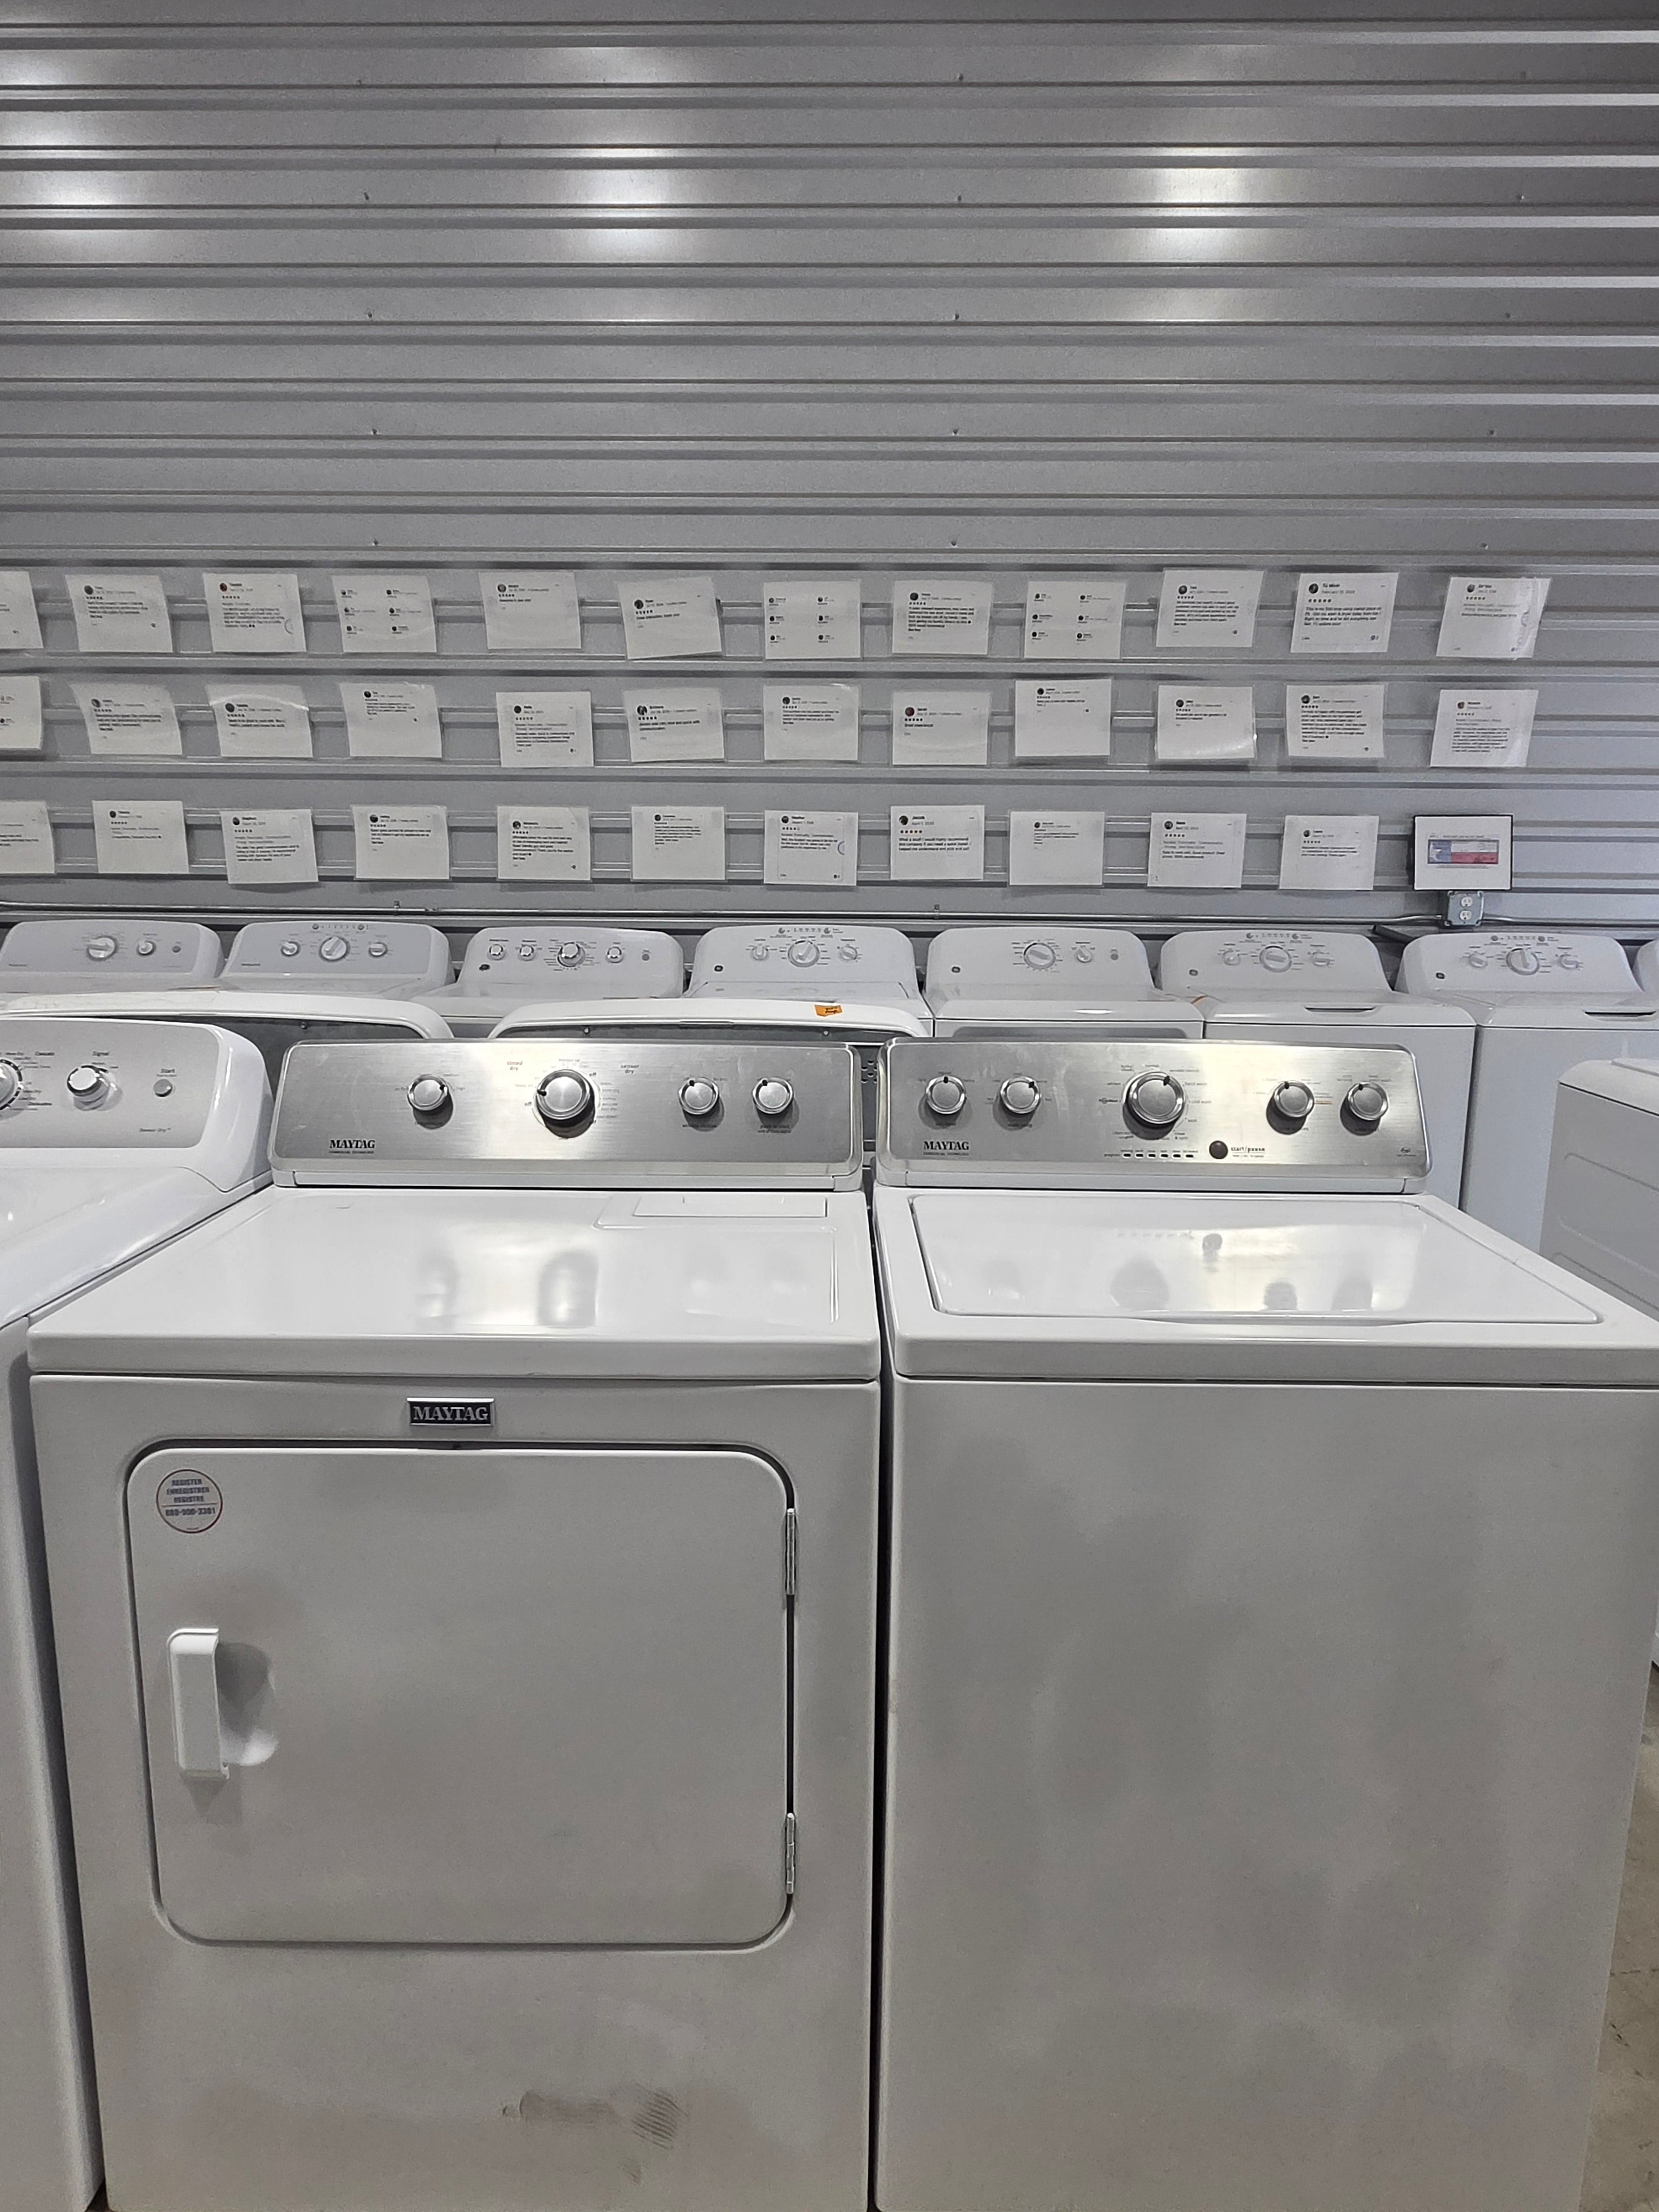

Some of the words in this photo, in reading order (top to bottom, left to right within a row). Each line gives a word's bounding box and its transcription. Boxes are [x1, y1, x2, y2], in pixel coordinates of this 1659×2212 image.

[329, 1139, 375, 1149] MAYTAG
[924, 1141, 969, 1151] MAYTAG
[413, 1406, 488, 1421] MAYTAG
